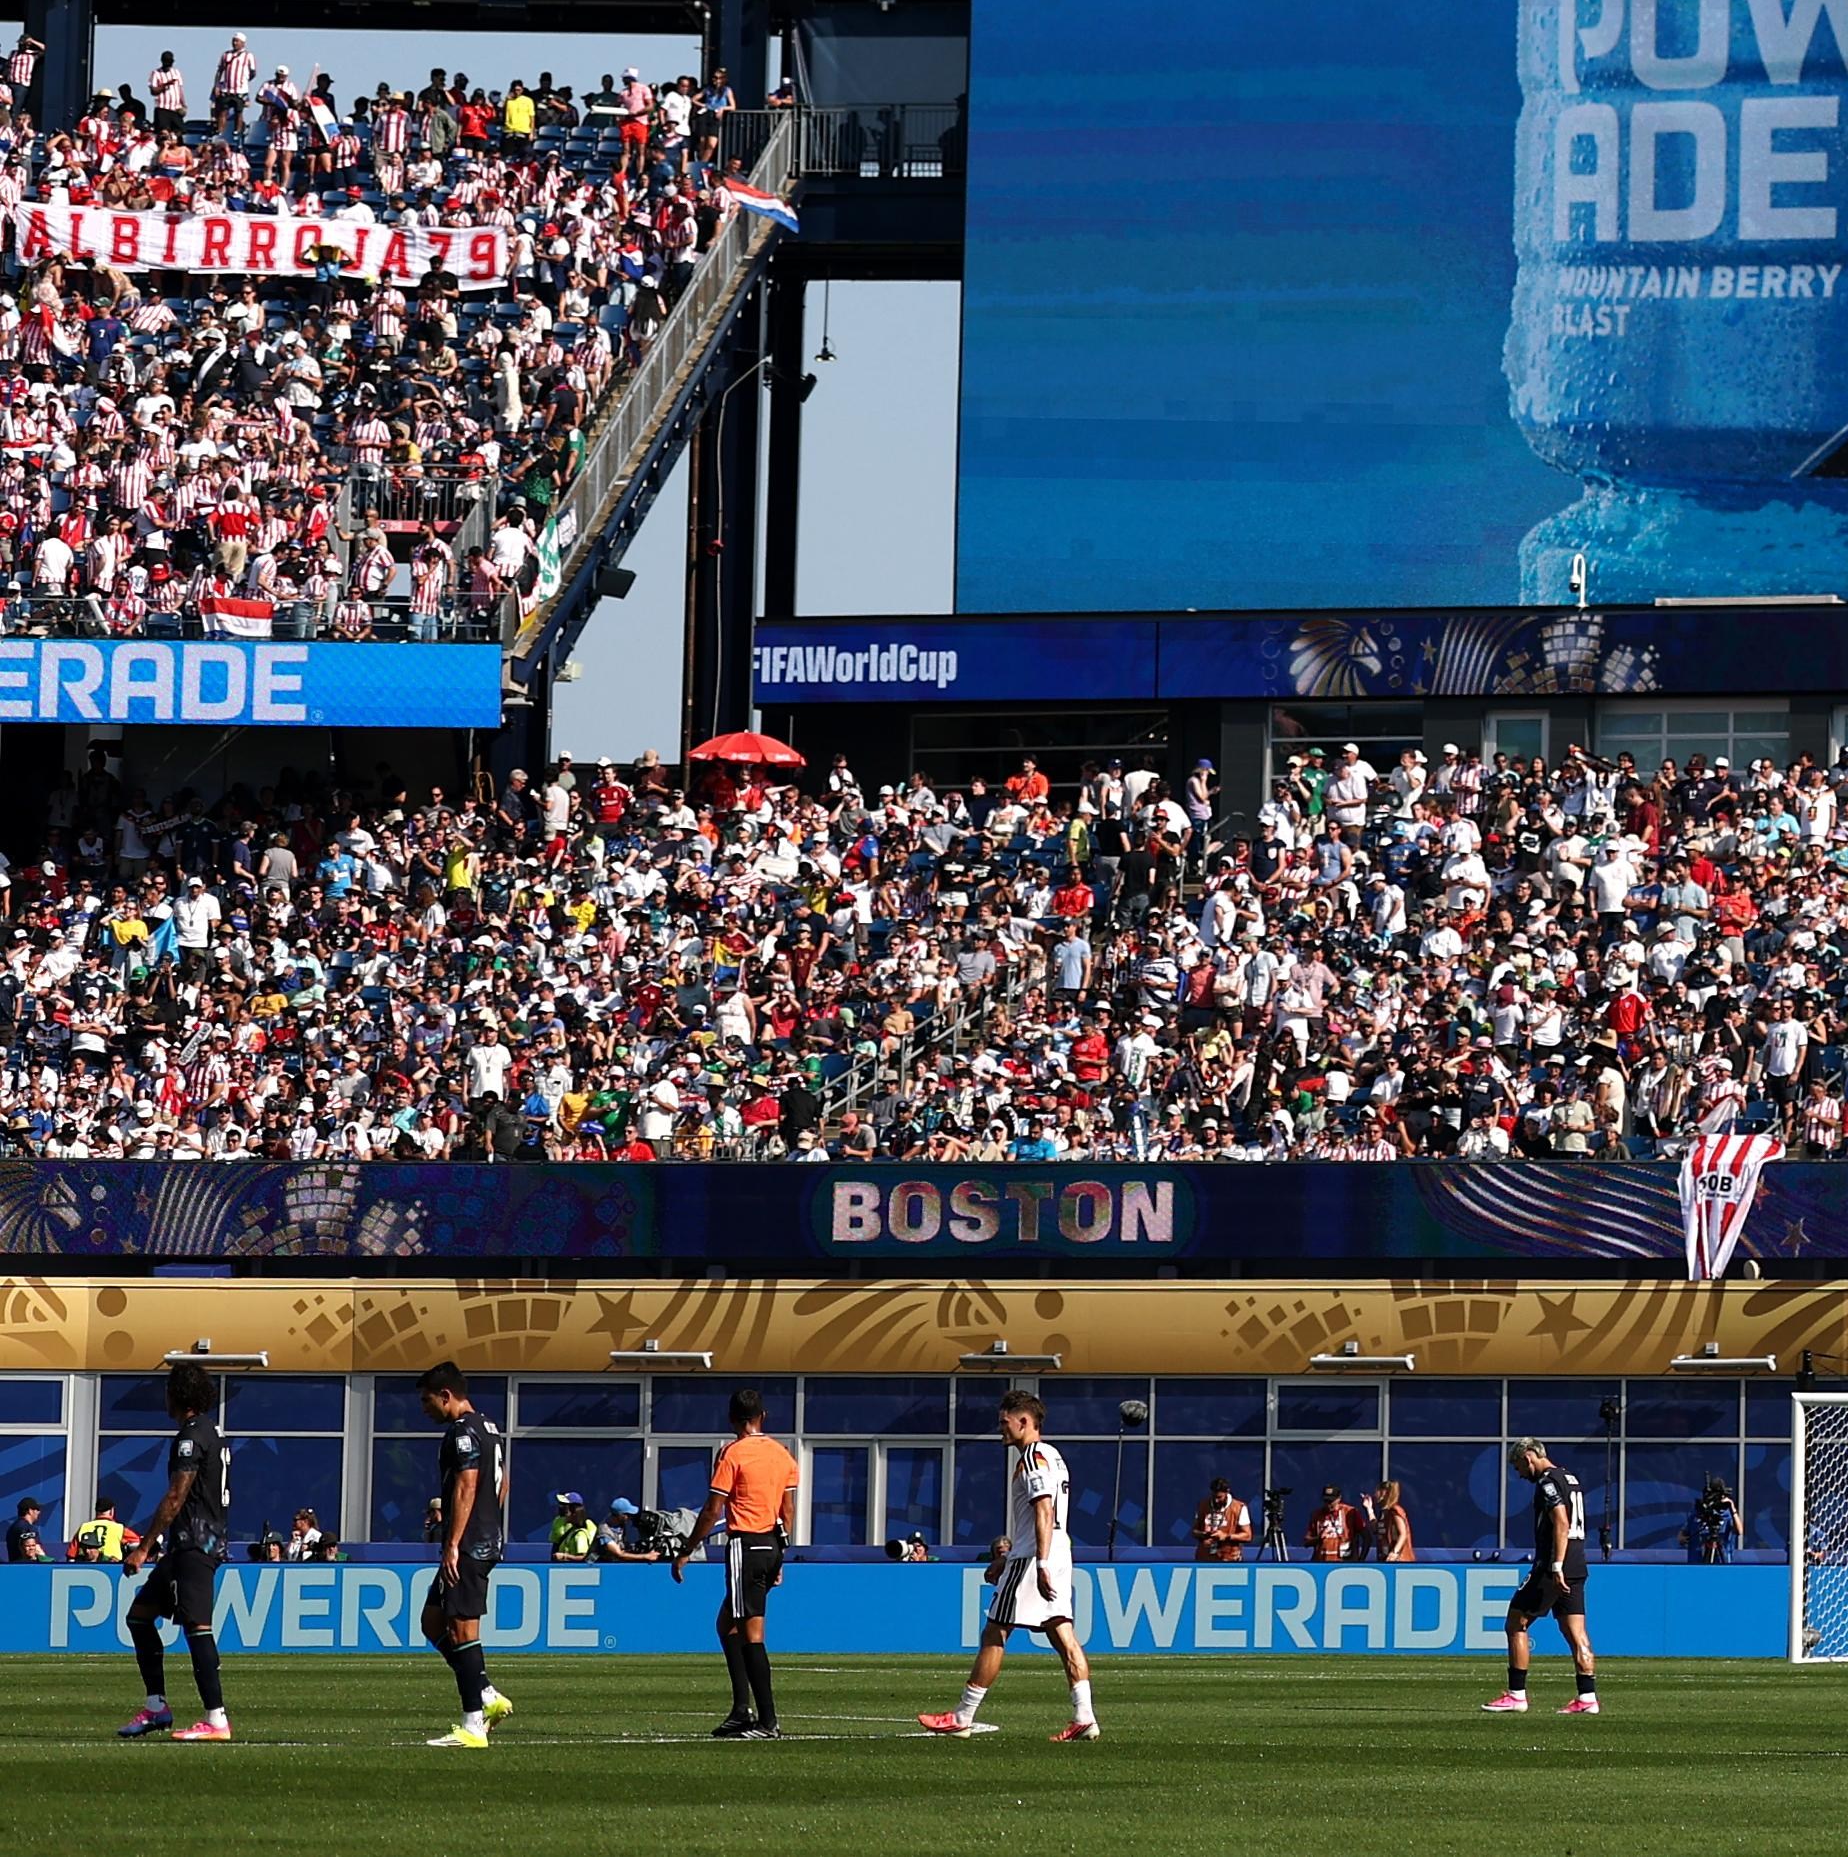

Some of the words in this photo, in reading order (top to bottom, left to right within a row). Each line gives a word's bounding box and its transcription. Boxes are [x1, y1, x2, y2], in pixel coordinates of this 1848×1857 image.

[1553, 95, 1839, 246] ADE
[1709, 264, 1842, 299] BERRY
[1552, 303, 1630, 337] BLAST
[831, 1181, 1175, 1243] BOSTON
